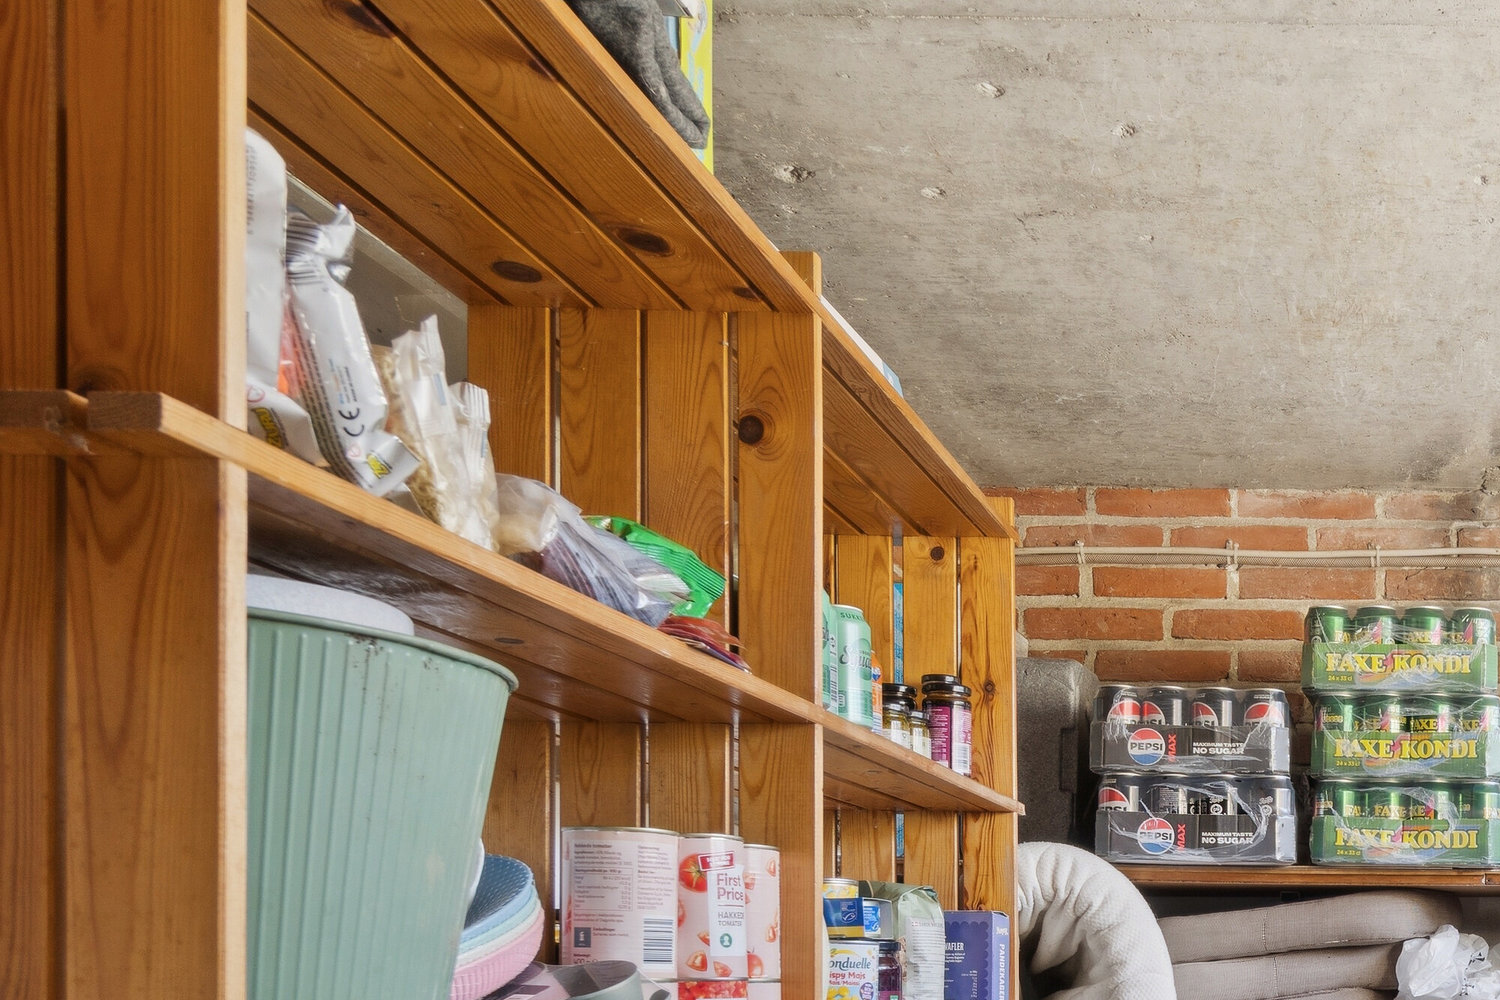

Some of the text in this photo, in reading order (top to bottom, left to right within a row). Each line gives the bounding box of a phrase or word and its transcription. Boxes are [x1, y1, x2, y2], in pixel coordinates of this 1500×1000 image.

[1326, 653, 1472, 675] FAXE KONDI
[1130, 742, 1163, 751] PEPSI
[1168, 734, 1177, 762] MAX
[1193, 747, 1245, 755] NO SUGAR
[1334, 738, 1479, 760] FAXE KONDI
[1139, 831, 1172, 841] PEPSI
[1177, 824, 1186, 851] MAX
[1401, 829, 1479, 850] KONDI
[716, 873, 742, 887] First
[717, 887, 744, 901] Price
[829, 957, 871, 972] onduelle
[998, 944, 1006, 1000] PANDEKAGER
[829, 972, 846, 980] ispy
